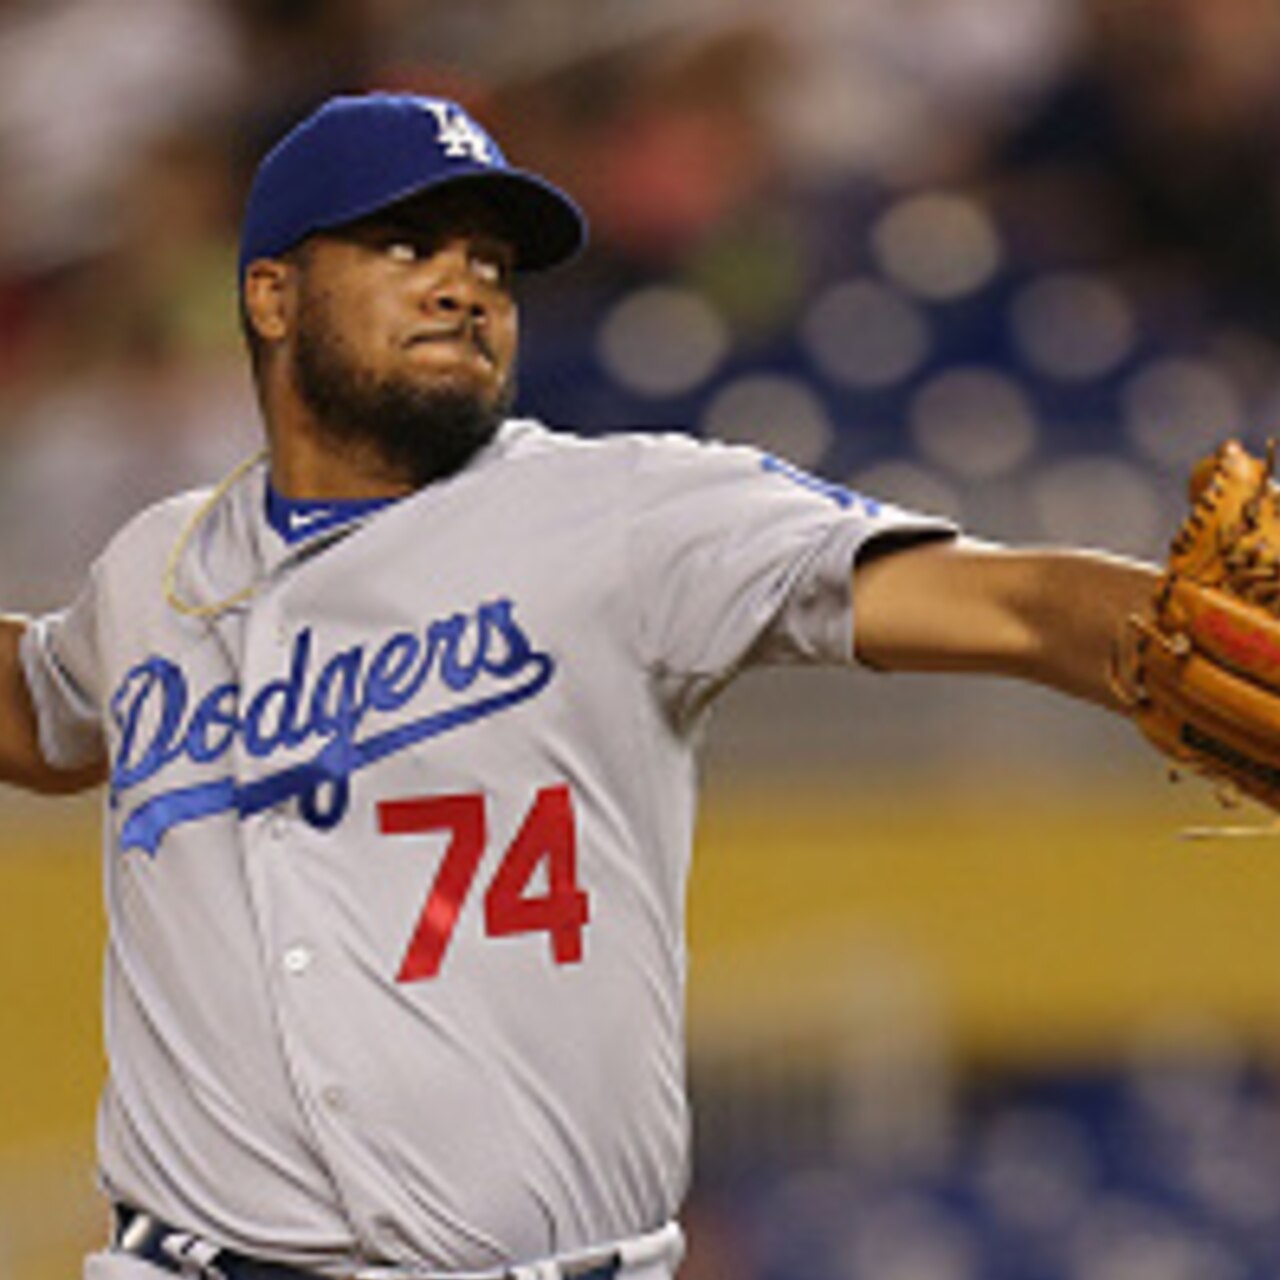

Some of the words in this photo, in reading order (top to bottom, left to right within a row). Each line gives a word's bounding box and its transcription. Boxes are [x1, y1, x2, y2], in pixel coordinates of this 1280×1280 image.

[423, 100, 492, 165] LA
[110, 598, 554, 832] Dodgers
[375, 785, 590, 985] 74
